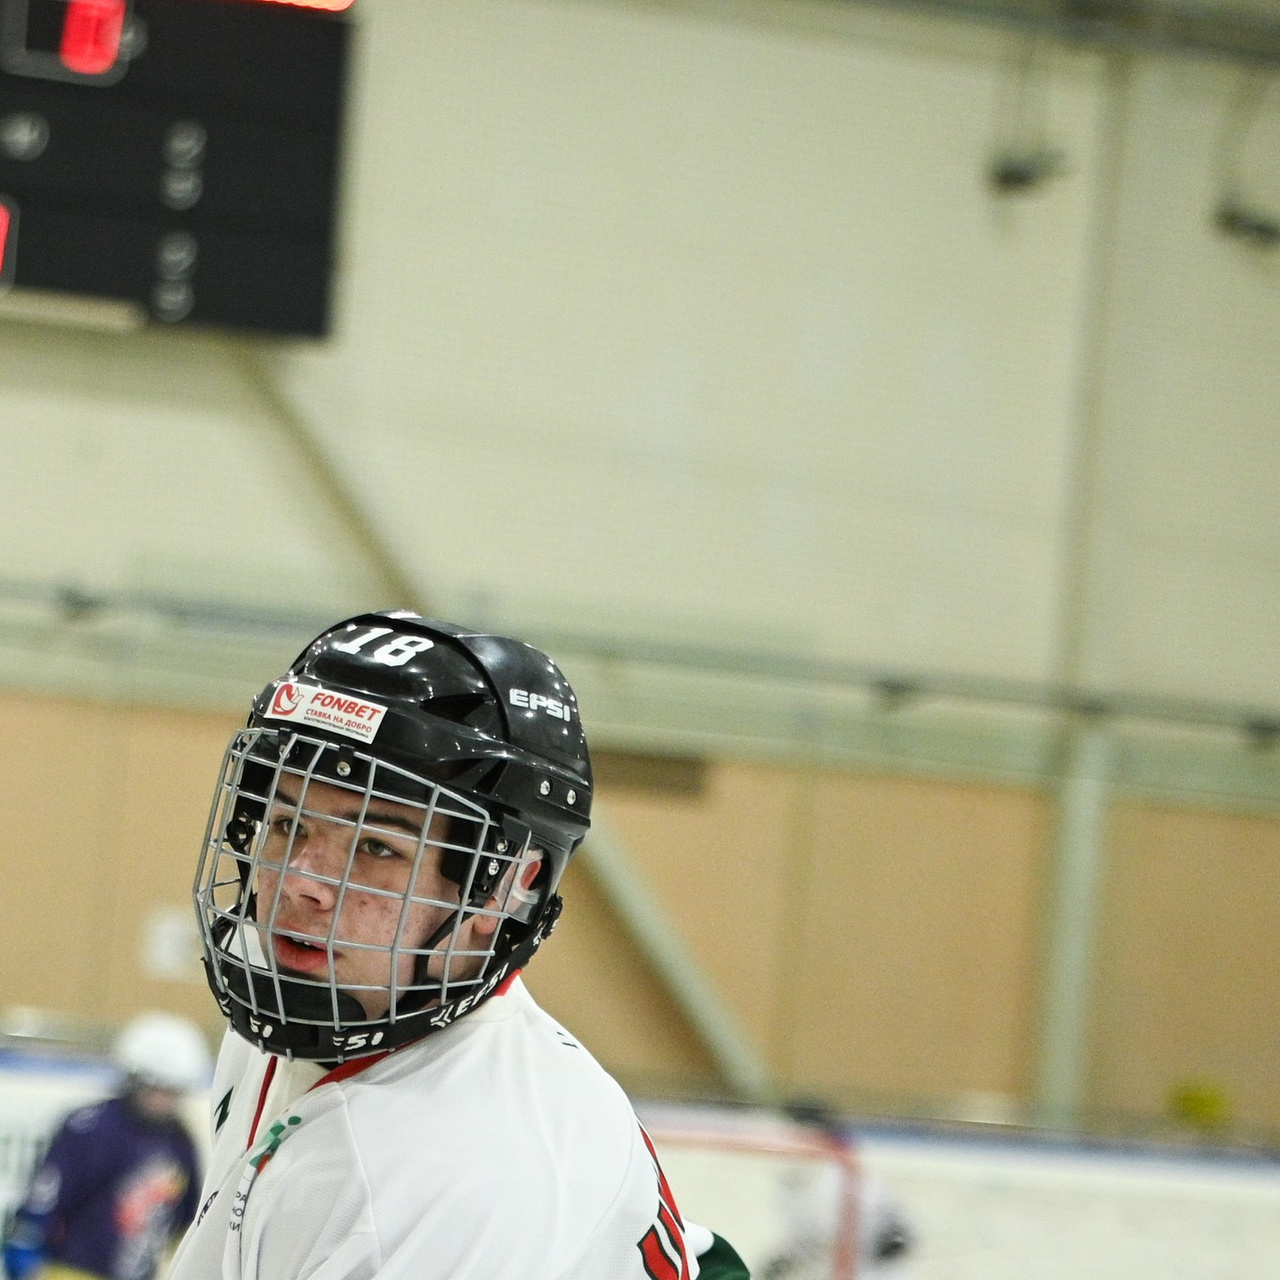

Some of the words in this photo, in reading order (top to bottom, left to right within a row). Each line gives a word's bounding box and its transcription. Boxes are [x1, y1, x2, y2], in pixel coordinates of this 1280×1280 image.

[337, 628, 434, 667] 18
[305, 708, 331, 720] СТАВКА
[333, 715, 343, 724] НА
[344, 719, 373, 733] ДОБРО
[310, 692, 381, 721] FONBET
[454, 962, 509, 1018] EFSI
